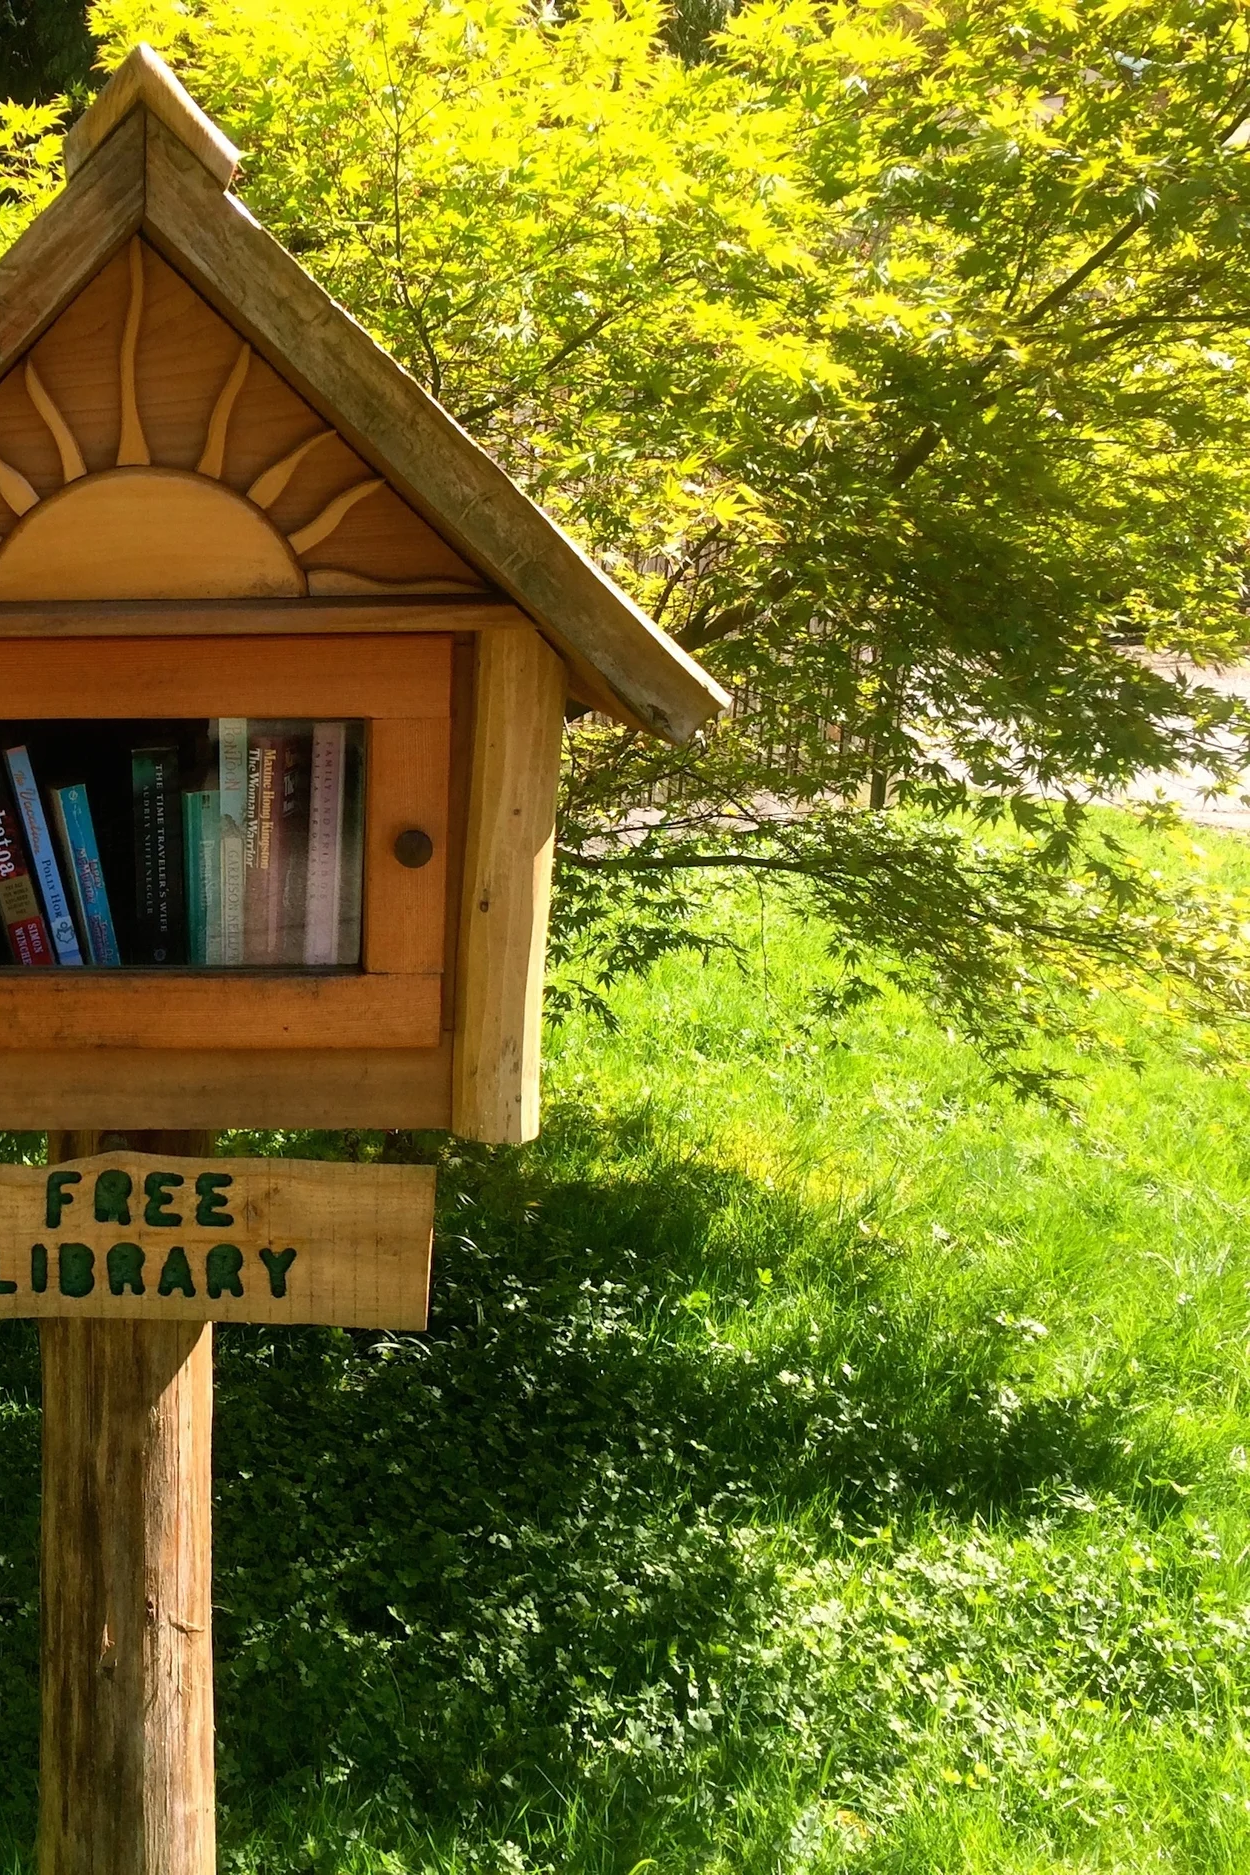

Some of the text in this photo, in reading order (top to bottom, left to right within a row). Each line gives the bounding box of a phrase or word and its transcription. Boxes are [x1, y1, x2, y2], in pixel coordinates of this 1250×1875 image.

[324, 742, 334, 790] FAMILY
[143, 784, 151, 828] AUDREY
[246, 748, 260, 868] The Woman Warrior
[258, 749, 276, 869] Maxine Hong Kingston
[323, 798, 331, 825] AND
[155, 764, 169, 932] THE TIME TRAVELER'S WIFE
[227, 850, 239, 911] GARRISON
[15, 927, 33, 966] WINCHE
[28, 923, 43, 954] SIMON
[45, 1168, 235, 1229] FREE
